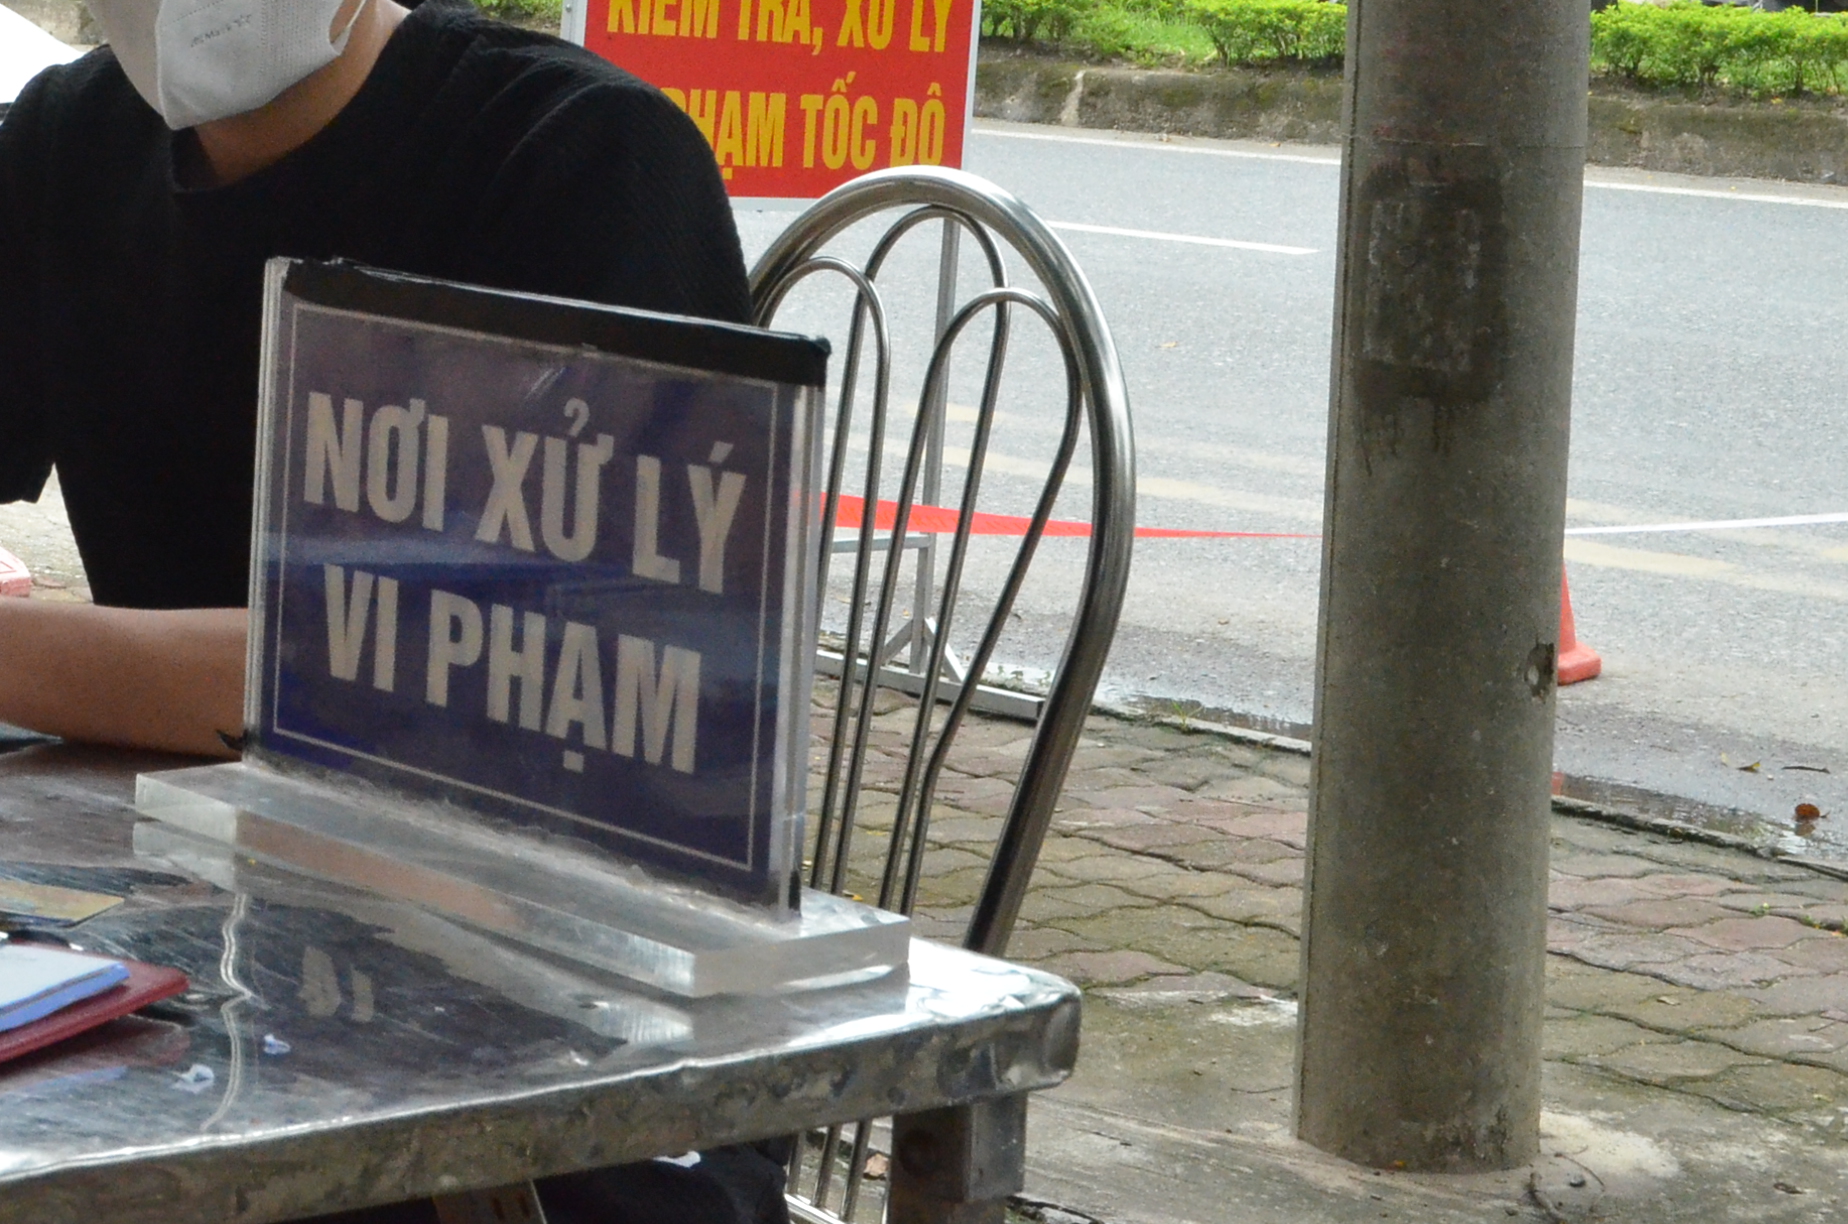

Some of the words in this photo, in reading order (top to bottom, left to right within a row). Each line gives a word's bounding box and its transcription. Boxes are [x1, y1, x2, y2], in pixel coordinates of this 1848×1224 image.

[660, 86, 786, 180] HẠM
[799, 71, 879, 170] TỐC
[303, 390, 450, 533] NƠI
[474, 397, 614, 563] XỬ
[631, 440, 747, 596] LÝ
[323, 562, 400, 694] VI
[426, 588, 702, 775] PHẠM
